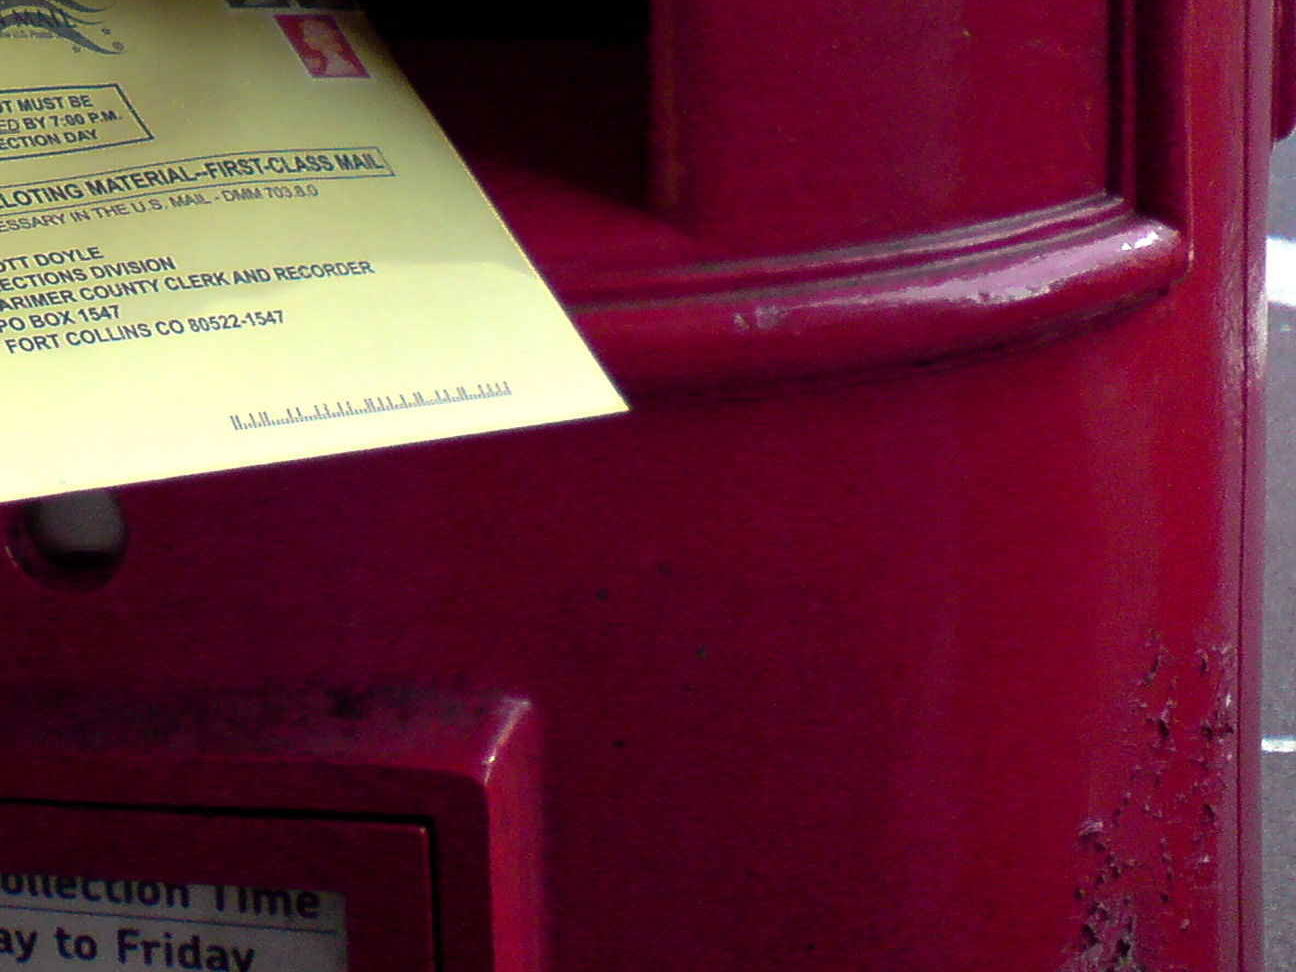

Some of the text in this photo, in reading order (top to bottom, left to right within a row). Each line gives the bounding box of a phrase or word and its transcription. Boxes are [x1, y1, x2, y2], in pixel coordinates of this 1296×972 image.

[17, 97, 64, 112] MUST
[71, 95, 93, 108] BE
[24, 117, 46, 130] BY
[90, 110, 122, 124] P.M.
[64, 129, 99, 144] DAY
[339, 153, 386, 170] MAIL
[72, 212, 94, 224] IN
[96, 203, 129, 220] THE
[132, 197, 167, 215] U.S.
[169, 193, 212, 208] MAIL
[222, 188, 264, 203] DMM
[34, 246, 104, 267] DOYLE
[90, 257, 176, 279] DIVISION
[80, 279, 159, 301] COUNTY
[164, 272, 230, 292] CLERK
[233, 268, 272, 284] AND
[273, 260, 376, 281] RECORDER
[30, 311, 75, 329] BOX
[78, 304, 121, 323] 1547
[5, 310, 284, 354] FORT COLLINS CO 80522-1547
[54, 927, 99, 960] to
[116, 928, 256, 972] Friday
